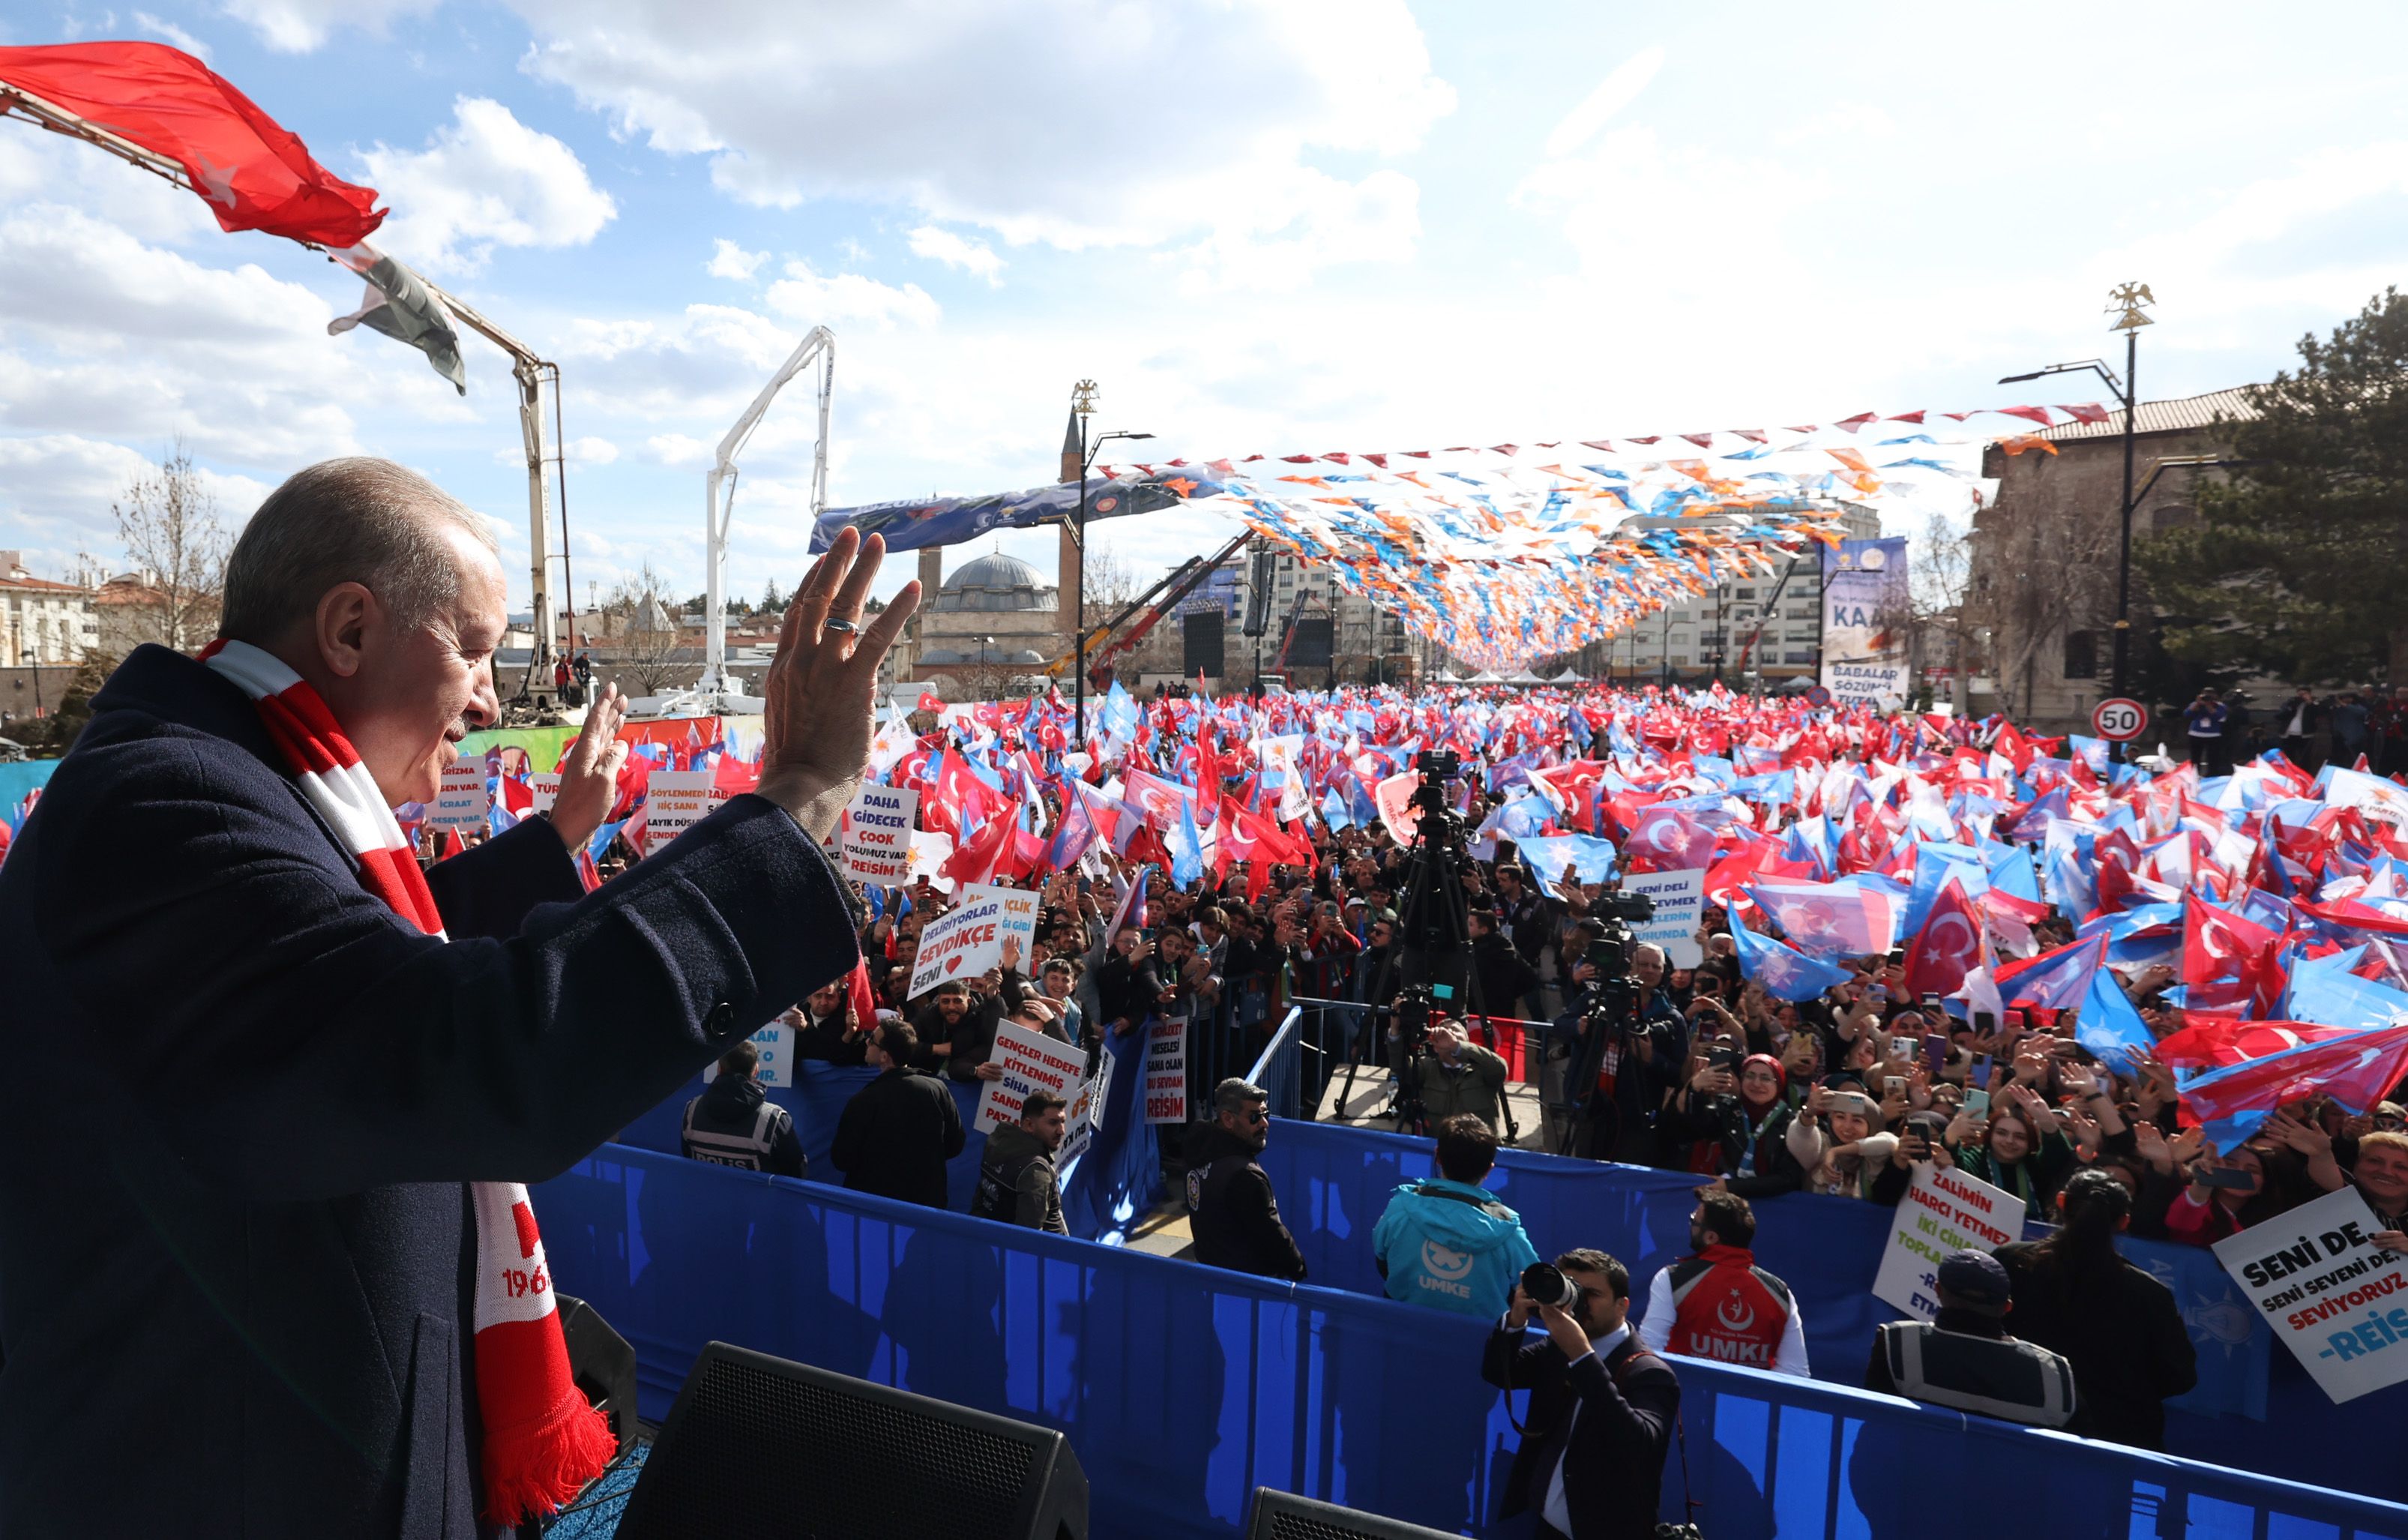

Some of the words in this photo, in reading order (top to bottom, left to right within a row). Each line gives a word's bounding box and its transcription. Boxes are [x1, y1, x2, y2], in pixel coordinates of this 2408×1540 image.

[1833, 666, 1898, 681] BABALAR
[2103, 711, 2135, 730] 50
[460, 783, 481, 792] VAR.
[650, 789, 705, 798] SÖYLENMEDİ
[439, 800, 472, 808] İCRAAT
[657, 801, 672, 811] HİÇ
[674, 802, 698, 810] SANA
[864, 795, 900, 809] DAHA
[432, 816, 459, 824] DESEN
[648, 819, 672, 827] LAYIK
[853, 810, 906, 828] GİDECEK
[859, 831, 895, 845] ÇOOK
[844, 843, 886, 858] YOLUMUZ
[889, 851, 906, 860] VAR
[851, 859, 895, 876] REİSİM
[1636, 883, 1661, 894] SENİ
[1664, 881, 1688, 892] DELİ
[1654, 896, 1697, 907] EVMEK
[923, 903, 998, 943] DELİRİYORLAR
[1013, 918, 1031, 932] GİBİ
[918, 923, 996, 967] SEVDİKÇE
[912, 960, 942, 992] SENİ
[1151, 1038, 1180, 1055] MESELESİ
[997, 1035, 1041, 1060] GENÇLER
[1042, 1054, 1080, 1077] HEDEFE
[1147, 1060, 1164, 1072] SANA
[1165, 1058, 1183, 1071] OLAN
[1003, 1056, 1064, 1092] KİTLENMİŞ
[1003, 1077, 1029, 1095] SİHA
[1147, 1078, 1156, 1090] BU
[1158, 1076, 1183, 1089] SEVDAM
[1147, 1092, 1183, 1118] REİSİM
[1933, 1172, 1993, 1214] ZALİMİN
[1909, 1185, 1952, 1218] HARCI
[1953, 1209, 2011, 1246] YETMEZ
[1917, 1212, 1939, 1236] İKİ
[2242, 1236, 2322, 1288] SENİ
[502, 1260, 551, 1299] 196
[1419, 1275, 1471, 1299] UMKE
[2262, 1284, 2305, 1312] SENİ
[2304, 1257, 2370, 1295] SEVENİ
[2368, 1249, 2401, 1269] DE,
[2287, 1272, 2408, 1331] SEVİYORUZ
